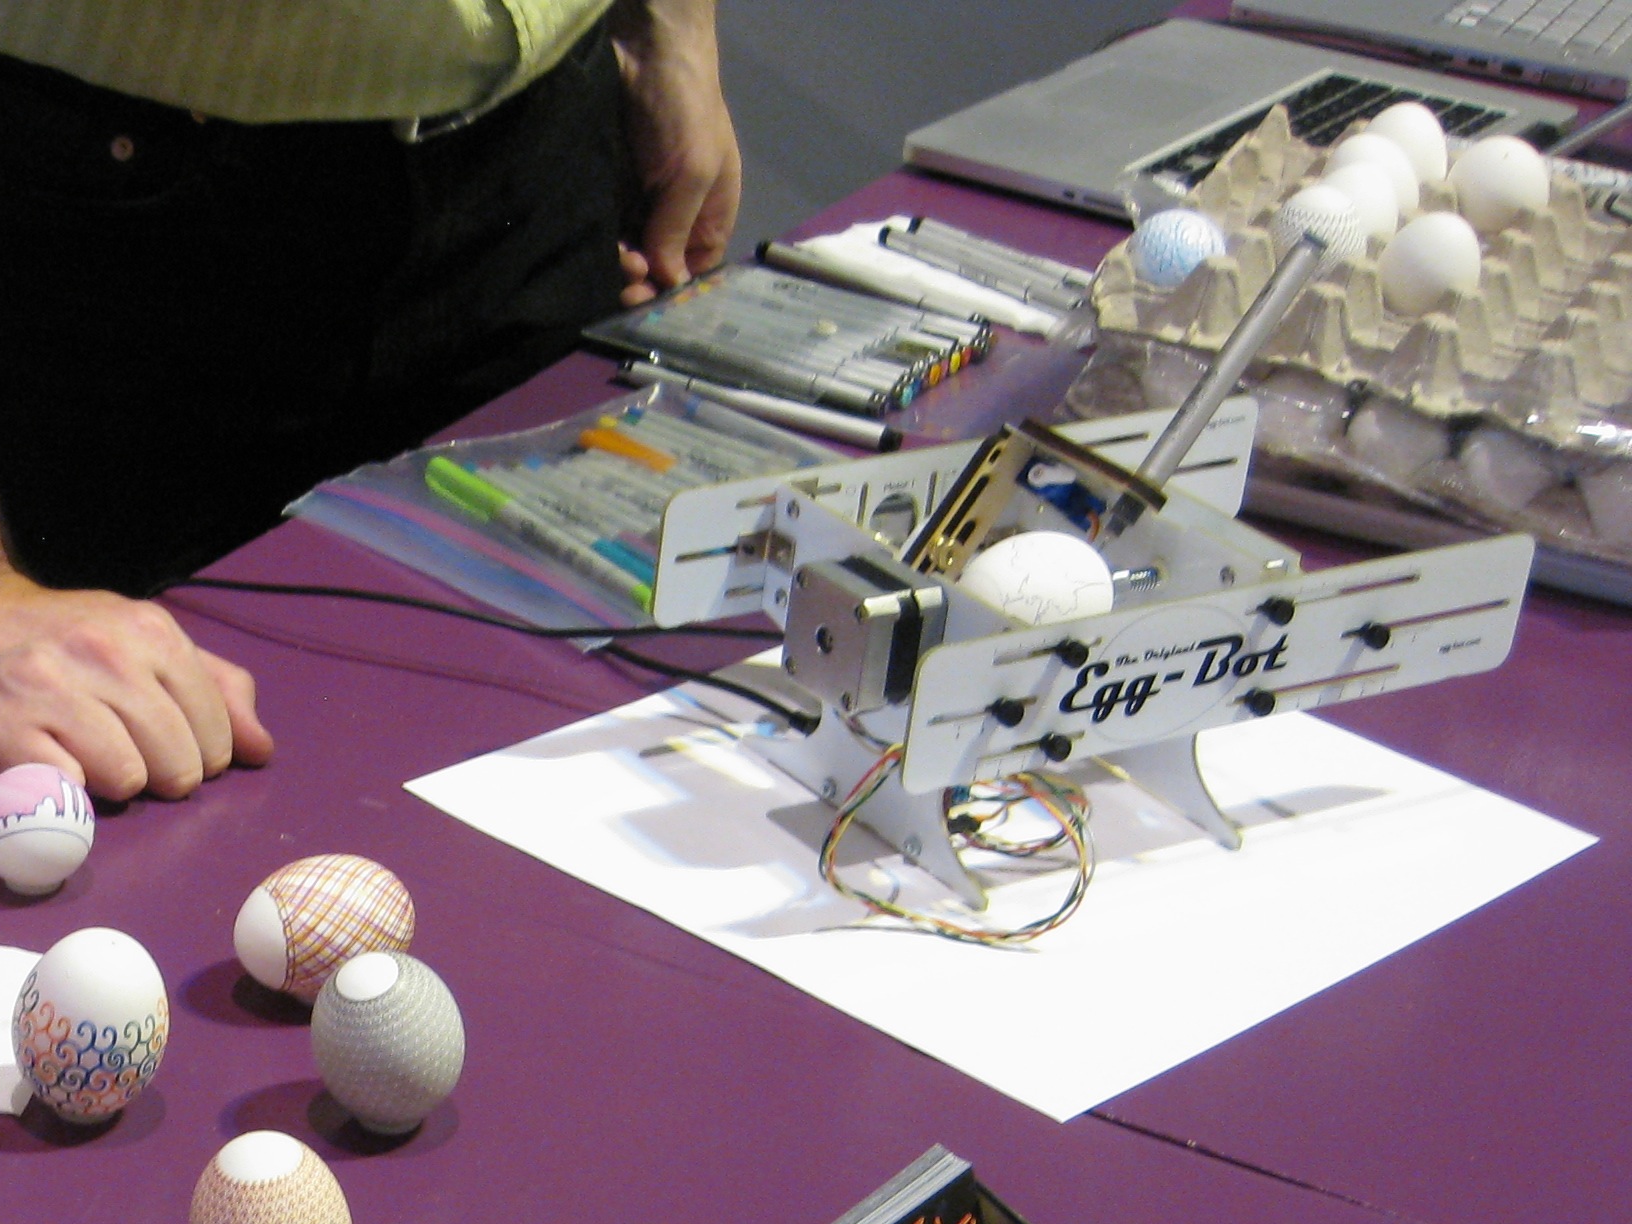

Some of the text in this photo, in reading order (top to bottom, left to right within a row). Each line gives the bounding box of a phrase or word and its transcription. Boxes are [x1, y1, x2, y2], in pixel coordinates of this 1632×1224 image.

[1058, 632, 1289, 724] Egg-Bot
[1116, 641, 1196, 667] The Original
